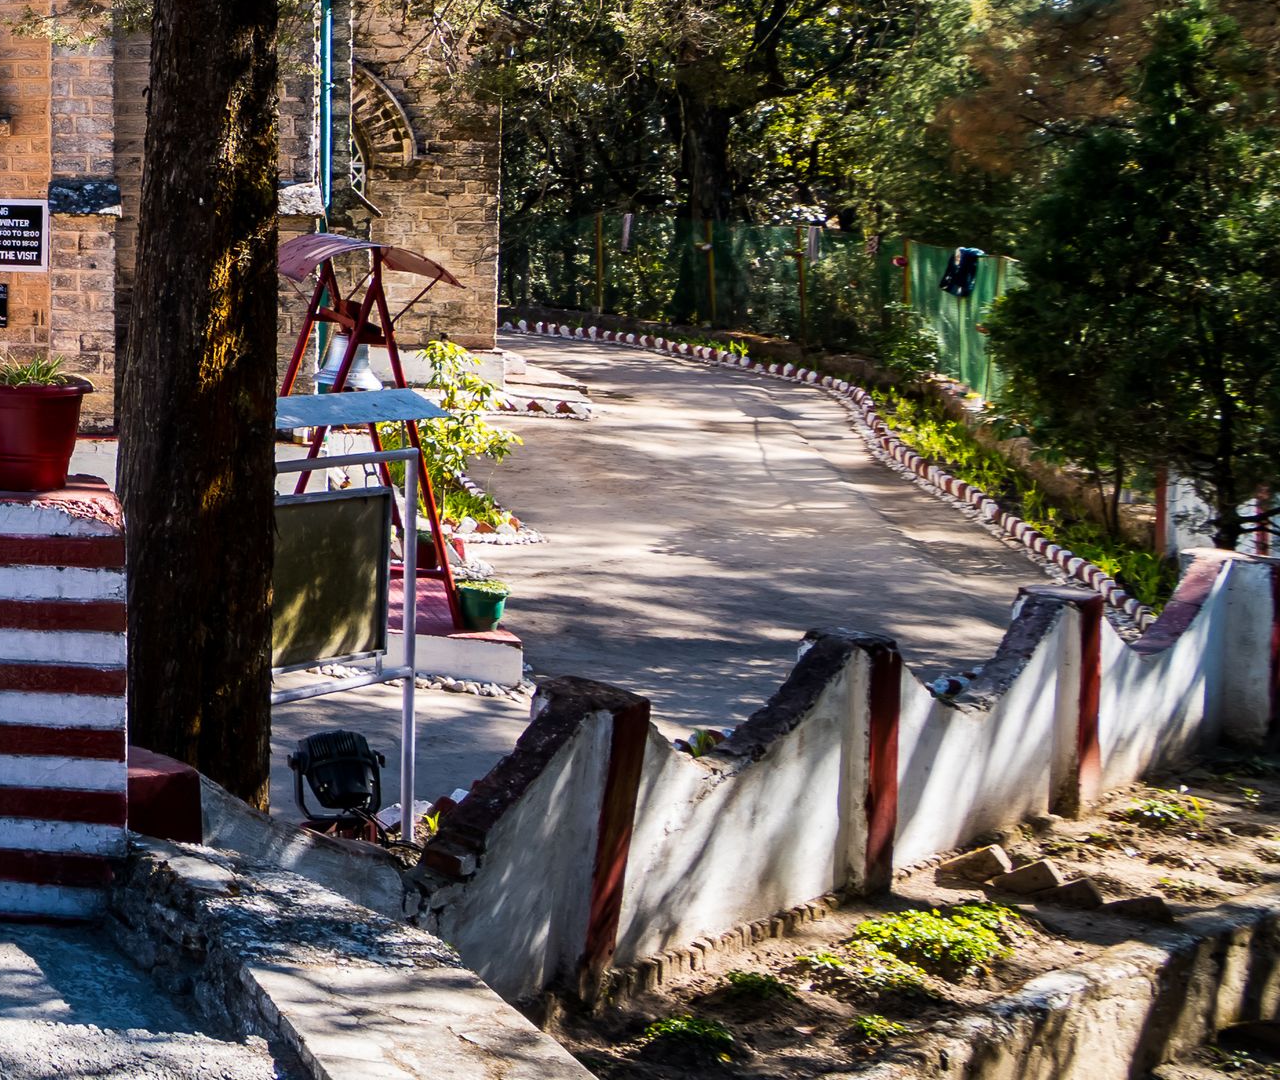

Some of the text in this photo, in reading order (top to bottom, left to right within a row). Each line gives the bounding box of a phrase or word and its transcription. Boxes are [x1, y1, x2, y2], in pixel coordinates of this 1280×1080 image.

[0, 218, 30, 227] WINTER
[12, 229, 22, 237] TO
[16, 251, 38, 260] VISIT
